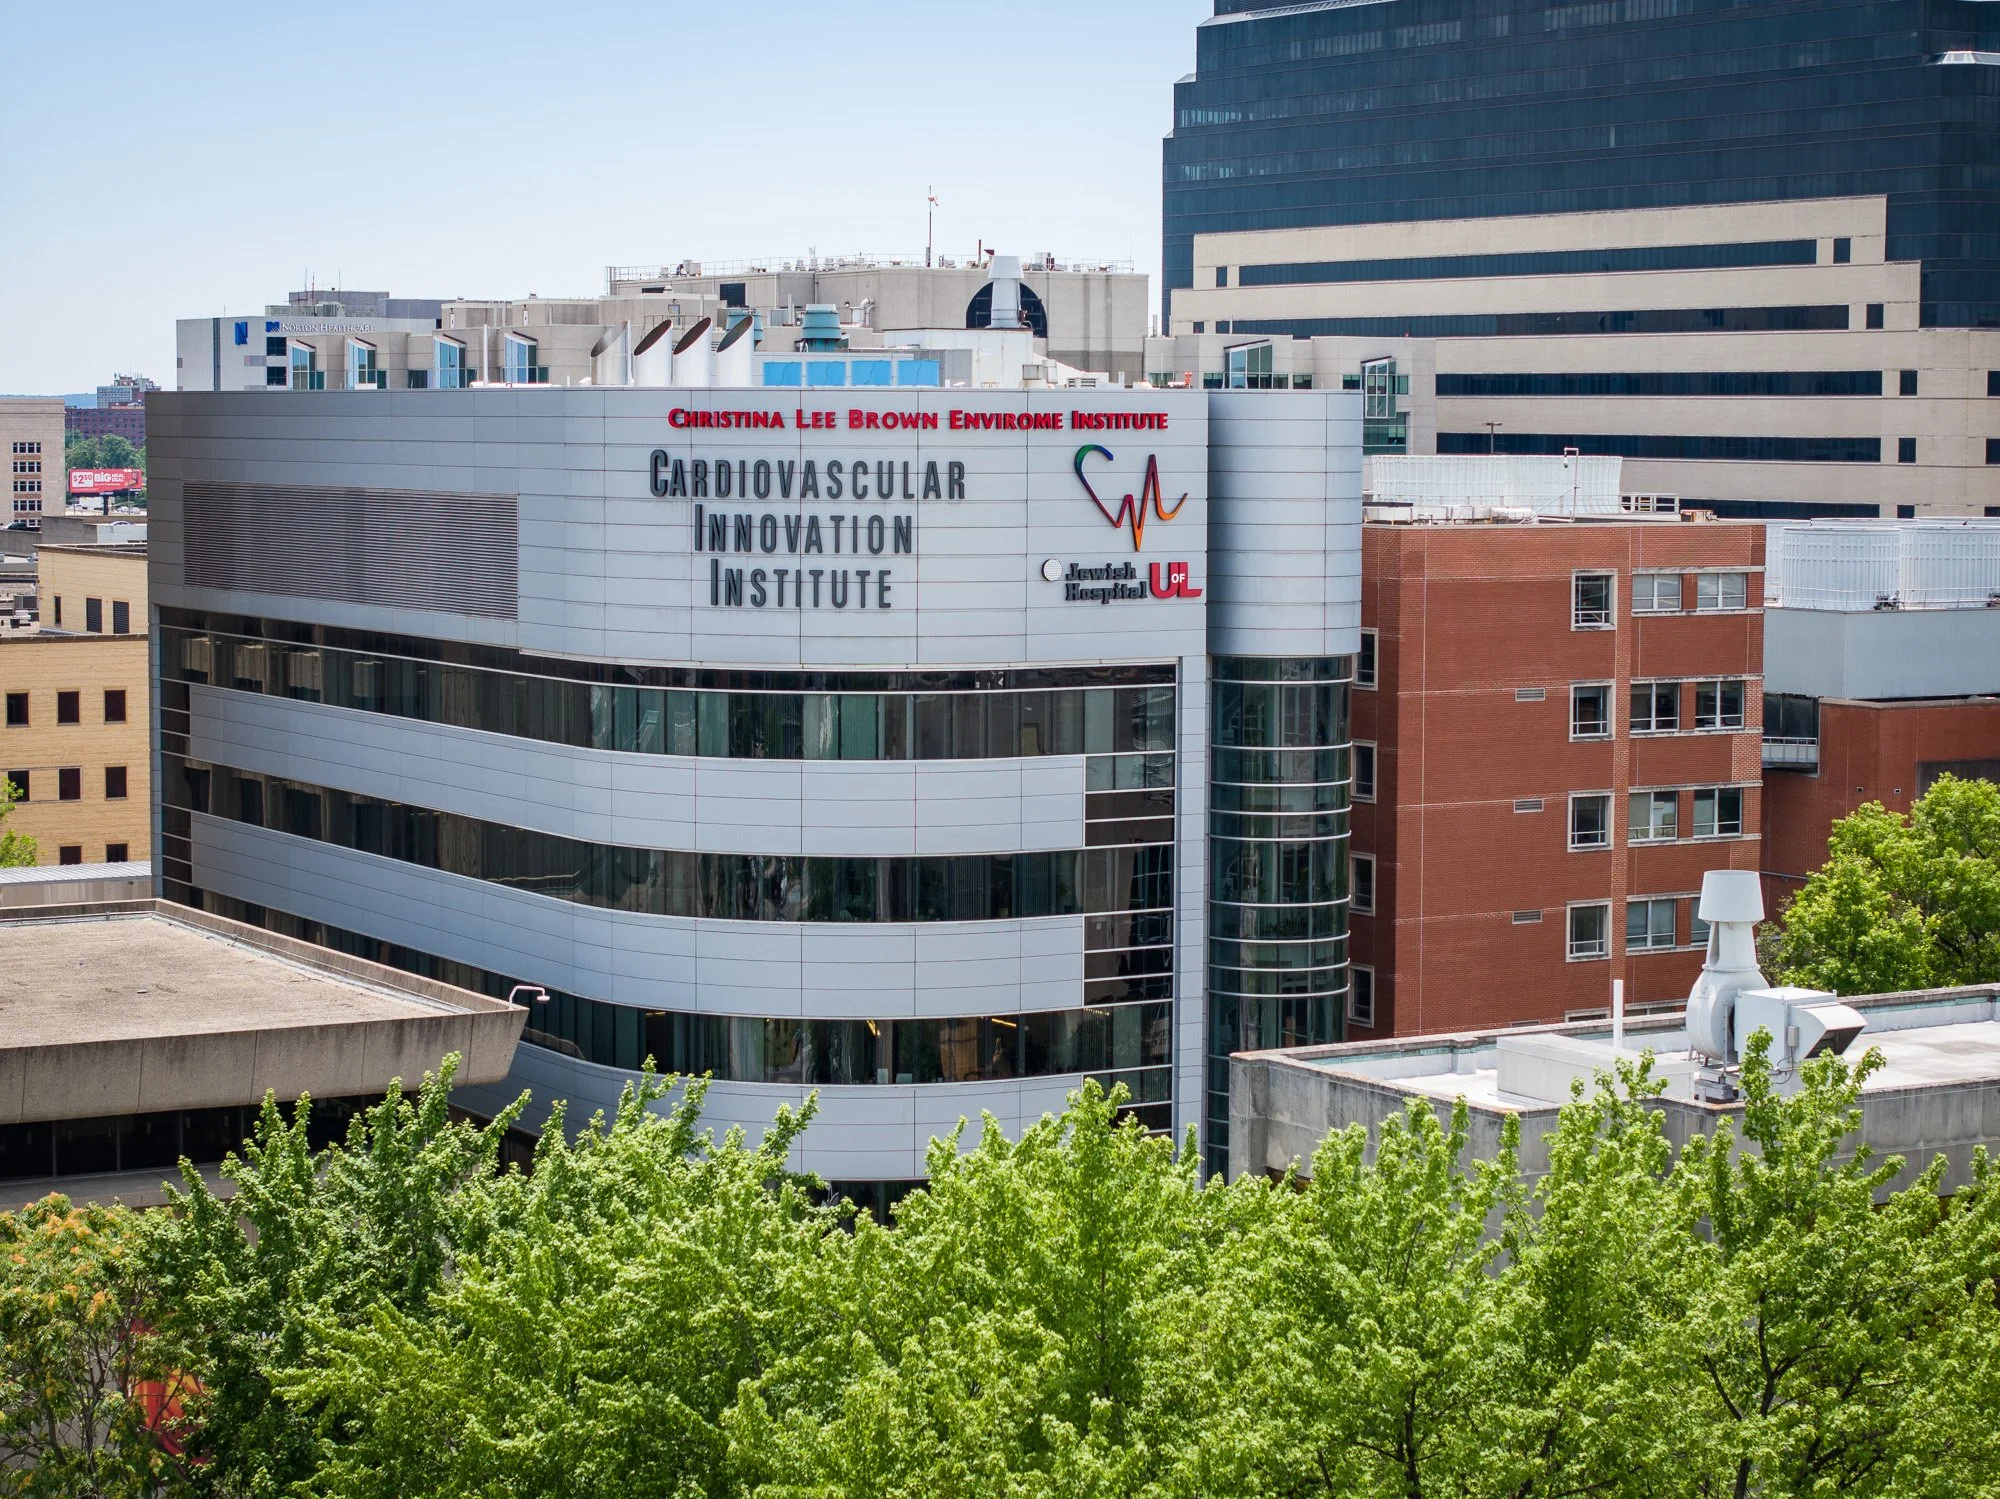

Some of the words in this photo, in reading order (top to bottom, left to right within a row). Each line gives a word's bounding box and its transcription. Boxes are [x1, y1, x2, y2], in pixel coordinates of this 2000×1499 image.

[282, 323, 317, 332] NORTON
[320, 323, 375, 332] HEALTHCARE
[668, 408, 784, 429] CHRISTINA
[795, 409, 837, 429] LEE
[849, 409, 938, 429] BROWN
[949, 410, 1064, 430] ENVIROME
[1071, 410, 1169, 430] INSTITUTE
[650, 449, 965, 500] CARDIOVASCULAR
[694, 503, 912, 554] INNOVATION
[1065, 562, 1137, 581] Jewish
[1171, 573, 1186, 584] OF
[710, 558, 892, 609] INSTITUTE
[1065, 581, 1148, 605] Hospital
